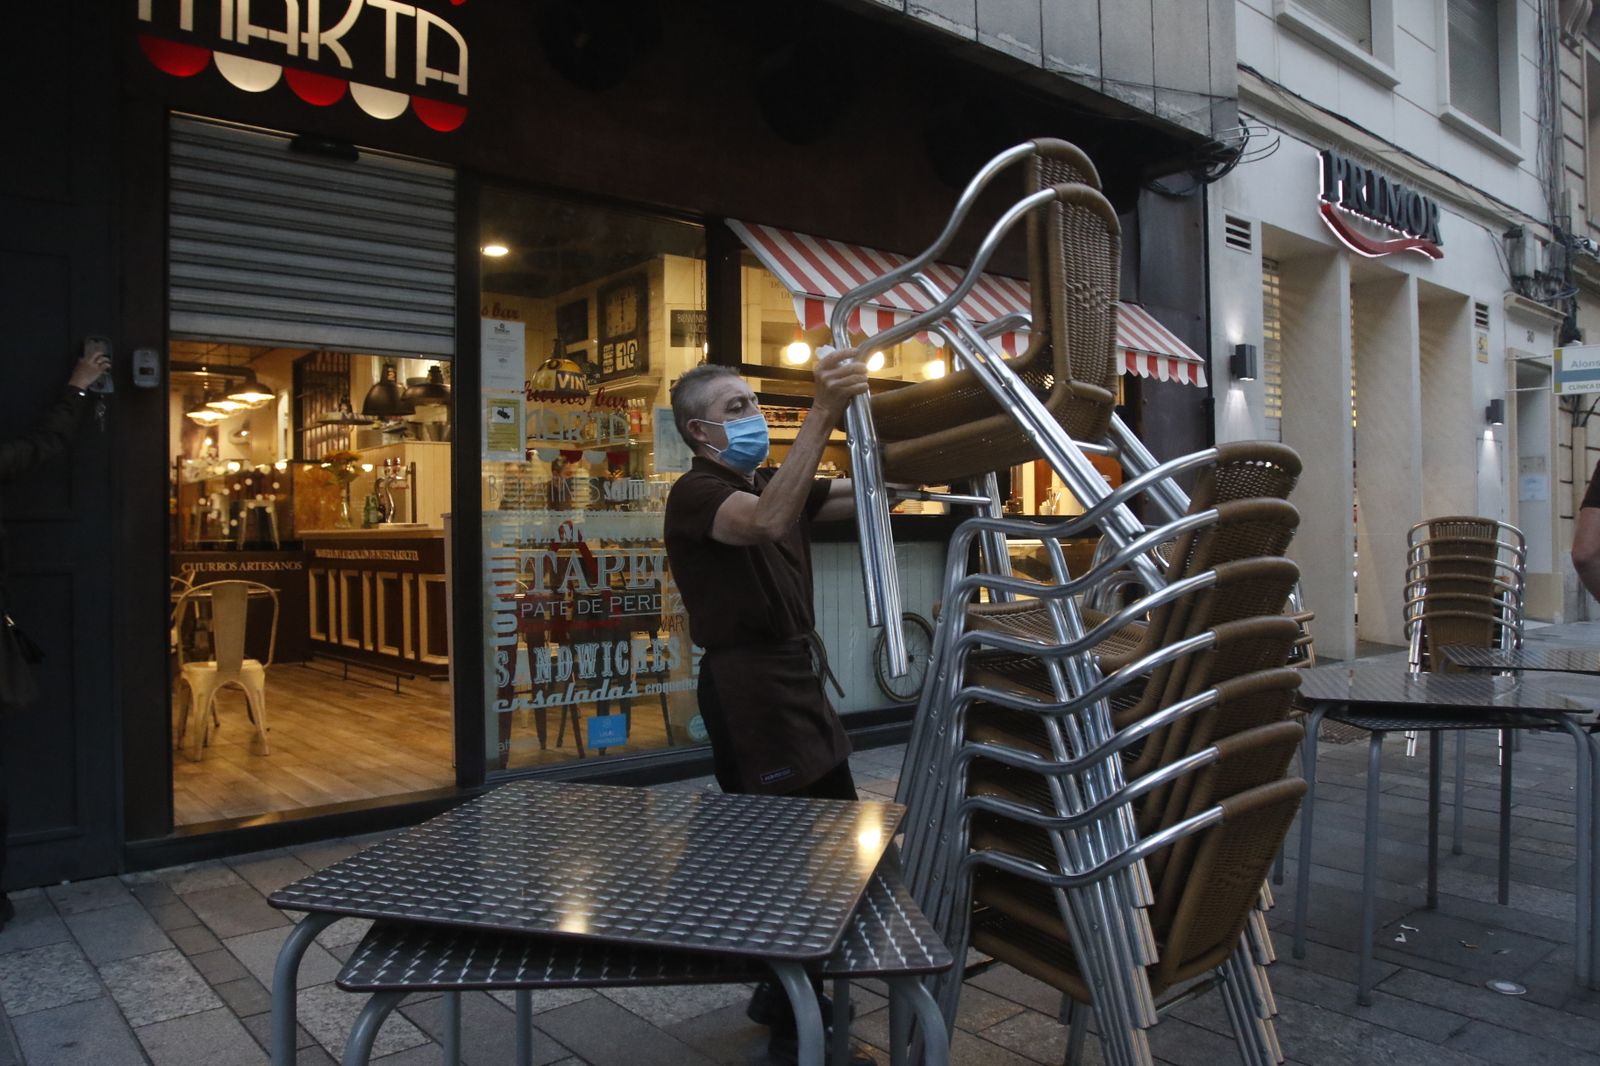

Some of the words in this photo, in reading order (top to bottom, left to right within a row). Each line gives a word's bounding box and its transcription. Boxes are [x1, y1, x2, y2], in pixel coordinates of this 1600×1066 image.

[1319, 150, 1443, 246] PRIMOR
[181, 560, 236, 573] CHURROS
[239, 560, 303, 572] ARTESANOS
[521, 600, 572, 618] PATE
[577, 598, 603, 615] DE
[495, 637, 682, 688] SANDWICHES
[491, 679, 641, 713] ensaladas
